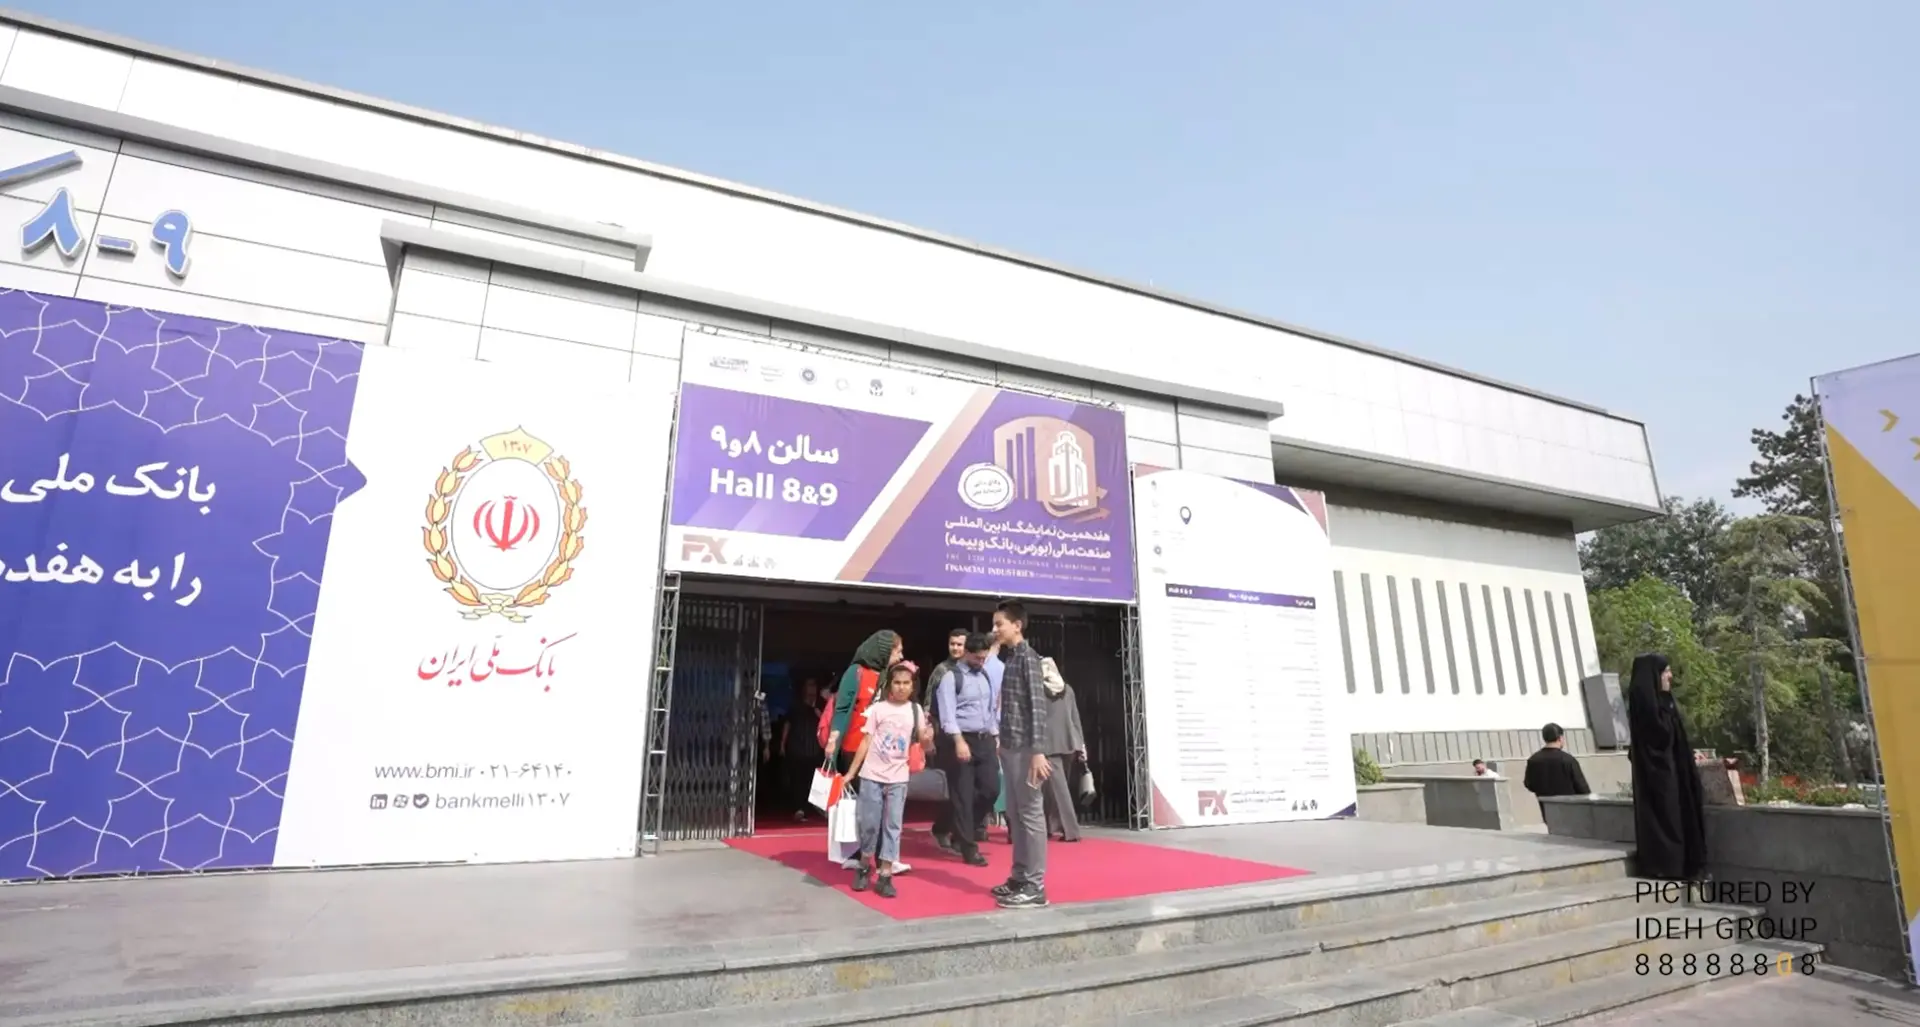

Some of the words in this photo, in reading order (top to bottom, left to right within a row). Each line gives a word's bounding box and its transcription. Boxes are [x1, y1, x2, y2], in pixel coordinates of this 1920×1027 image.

[768, 434, 840, 465] سالن
[0, 453, 95, 503] ملی
[105, 461, 216, 515] بانک
[709, 468, 774, 500] Hall
[782, 478, 839, 506] 8&9
[0, 542, 104, 584] هفد
[113, 559, 160, 601] به
[170, 552, 202, 607] را
[417, 643, 477, 687] ایران
[496, 632, 578, 692] بانک
[374, 763, 475, 779] www.bmi.ir
